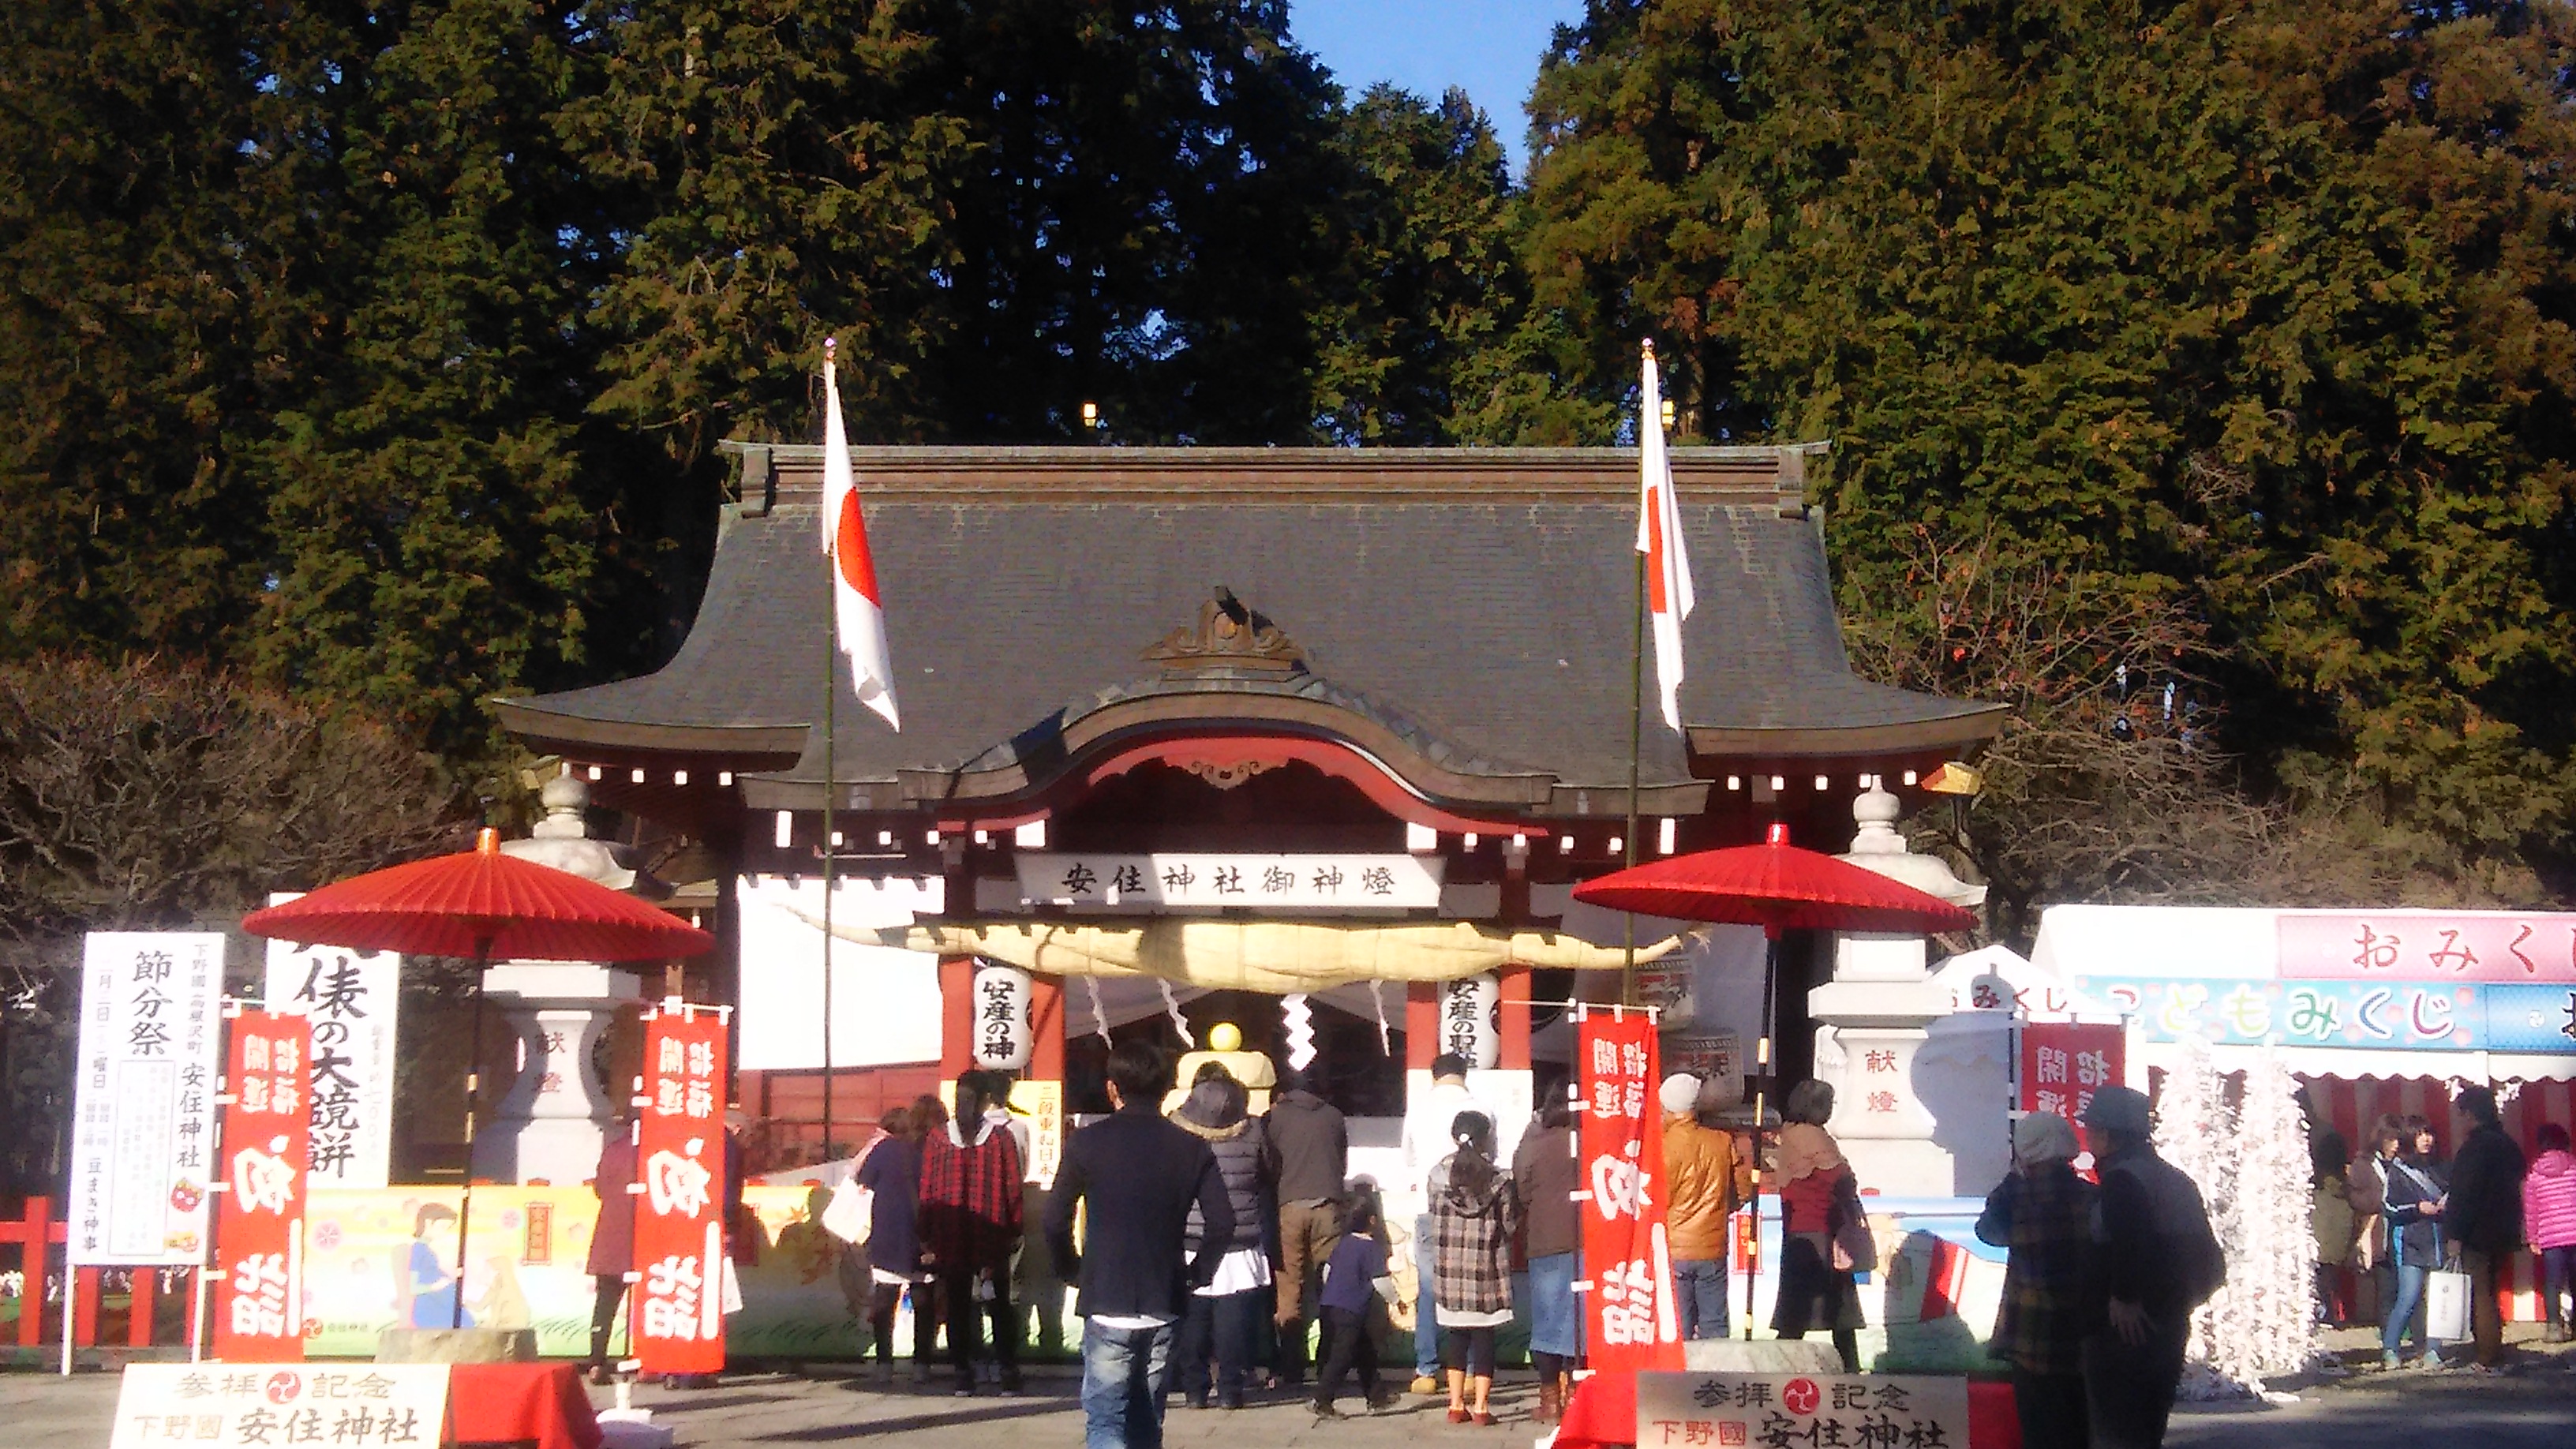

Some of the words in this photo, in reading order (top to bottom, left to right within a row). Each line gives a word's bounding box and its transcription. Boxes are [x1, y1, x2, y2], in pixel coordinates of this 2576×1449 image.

[1061, 862, 1396, 896] 安住神社御神燈
[2353, 923, 2576, 974] おみく
[127, 950, 174, 1056] 節分祭
[982, 979, 1016, 1060] 安産の神
[293, 942, 380, 1178] 俵の大鏡餅
[1865, 1049, 1898, 1113] 献燈
[177, 1062, 205, 1167] 安住神社
[174, 1372, 259, 1399] 参拝
[312, 1372, 396, 1400] 記念
[1694, 1379, 1773, 1408] 参拝
[1831, 1382, 1911, 1412] 記念
[236, 1406, 419, 1445] 安住神社
[1755, 1410, 1949, 1449] 安住神社
